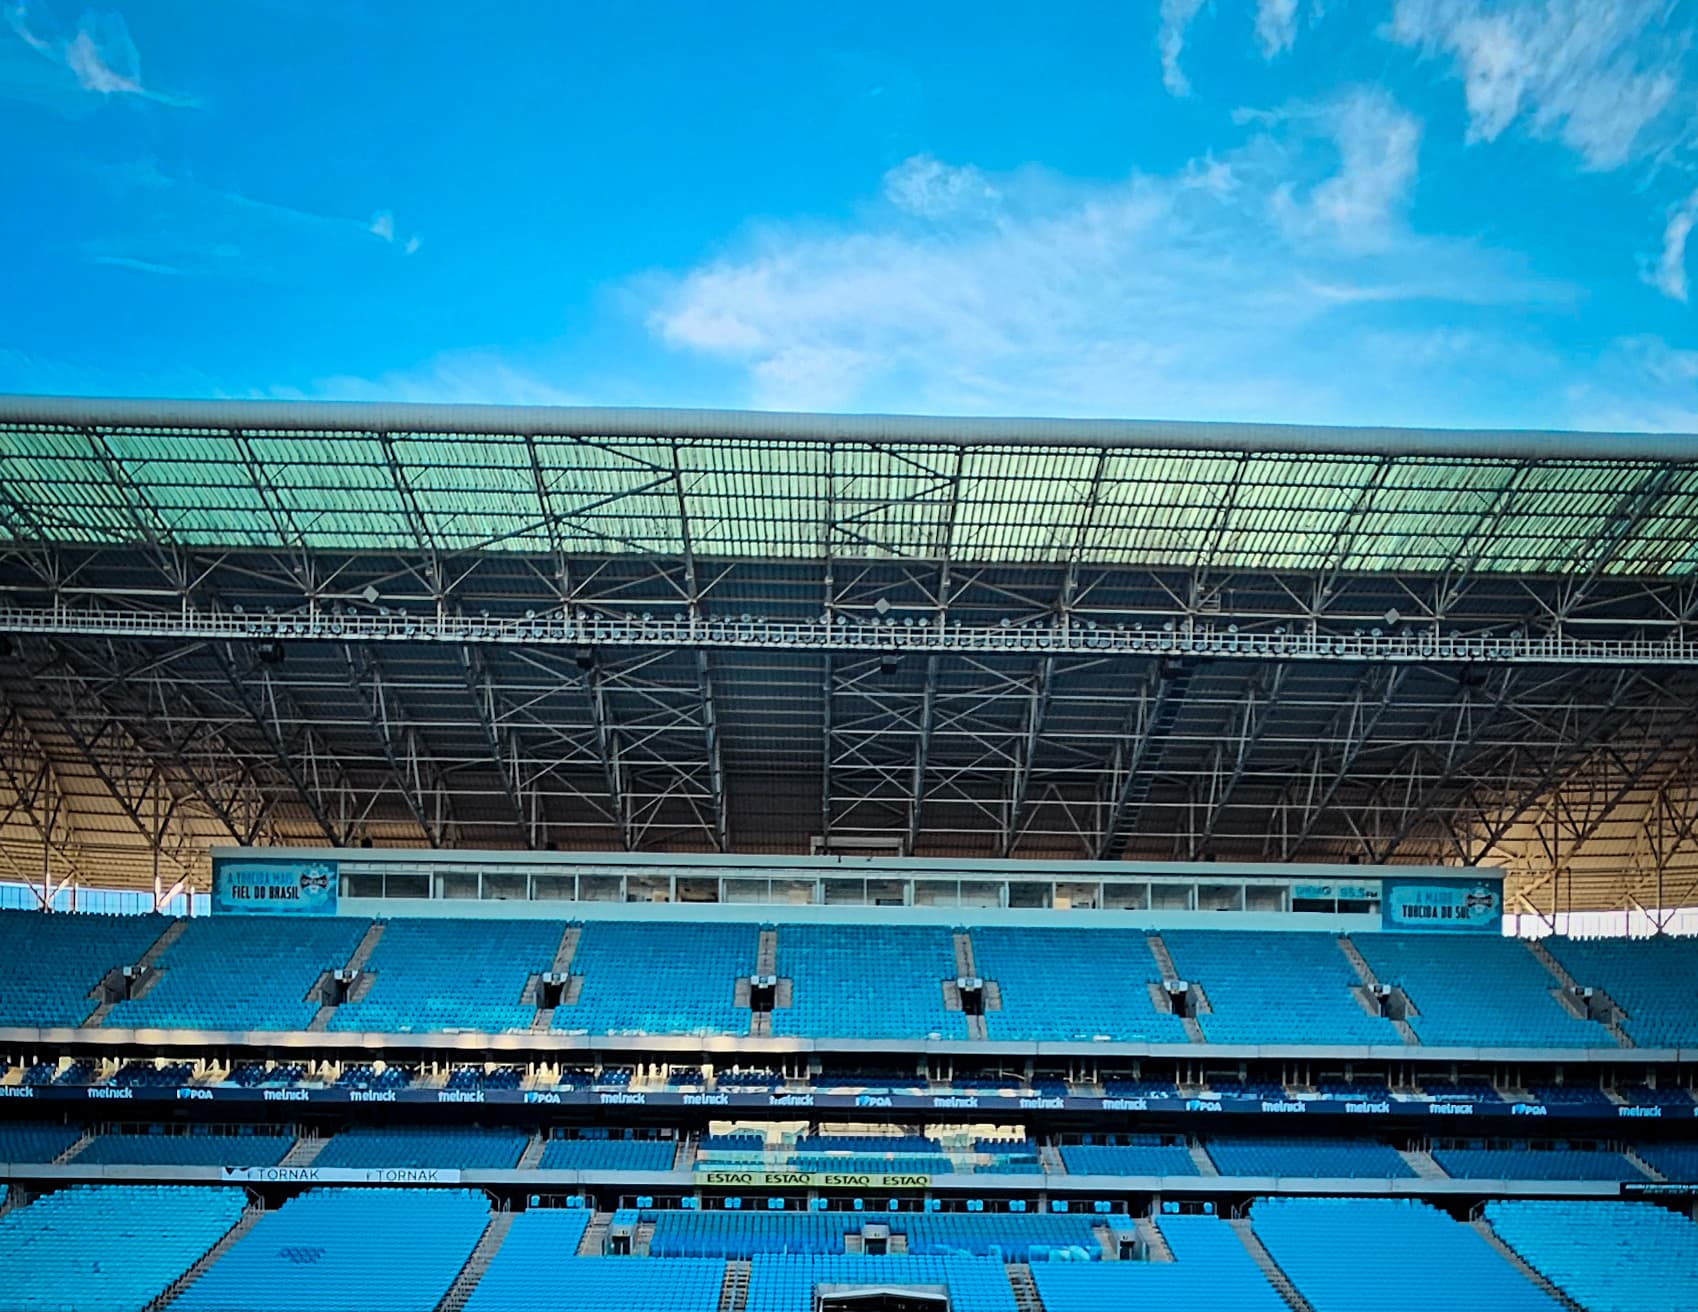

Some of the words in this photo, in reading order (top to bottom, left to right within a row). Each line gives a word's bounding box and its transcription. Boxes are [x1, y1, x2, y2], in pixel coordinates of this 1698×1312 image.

[232, 886, 250, 899] FIEL
[254, 886, 266, 899] DO
[269, 886, 300, 899] BRASIL
[1402, 904, 1438, 918] TORCIDA
[1441, 905, 1453, 919] DO
[1455, 906, 1471, 919] SUL
[0, 1086, 33, 1097] elnick
[87, 1087, 133, 1099] melnick
[191, 1089, 214, 1100] POA
[264, 1089, 309, 1101] melnick
[350, 1090, 396, 1102] melnick
[438, 1090, 484, 1103] melnick
[538, 1093, 561, 1104] POA
[600, 1092, 645, 1104] melnick
[683, 1093, 728, 1105] melnick
[769, 1094, 814, 1105] melnick
[870, 1097, 892, 1107] POA
[934, 1097, 978, 1108] melnick
[1020, 1097, 1064, 1109] melnick
[1103, 1099, 1148, 1110] melnick
[1200, 1101, 1222, 1111] POA
[1262, 1101, 1306, 1112] melnick
[1345, 1101, 1389, 1113] melnick
[1429, 1102, 1473, 1114] melnick
[1525, 1105, 1547, 1115] POA
[1618, 1105, 1661, 1117] melnick
[257, 1168, 320, 1180] TORNAK
[376, 1169, 438, 1181] TORNAK
[707, 1173, 752, 1184] ESTAQ
[765, 1174, 810, 1184] ESTAQ
[825, 1175, 870, 1186] ESTAQ
[883, 1176, 928, 1187] ESTAQ
